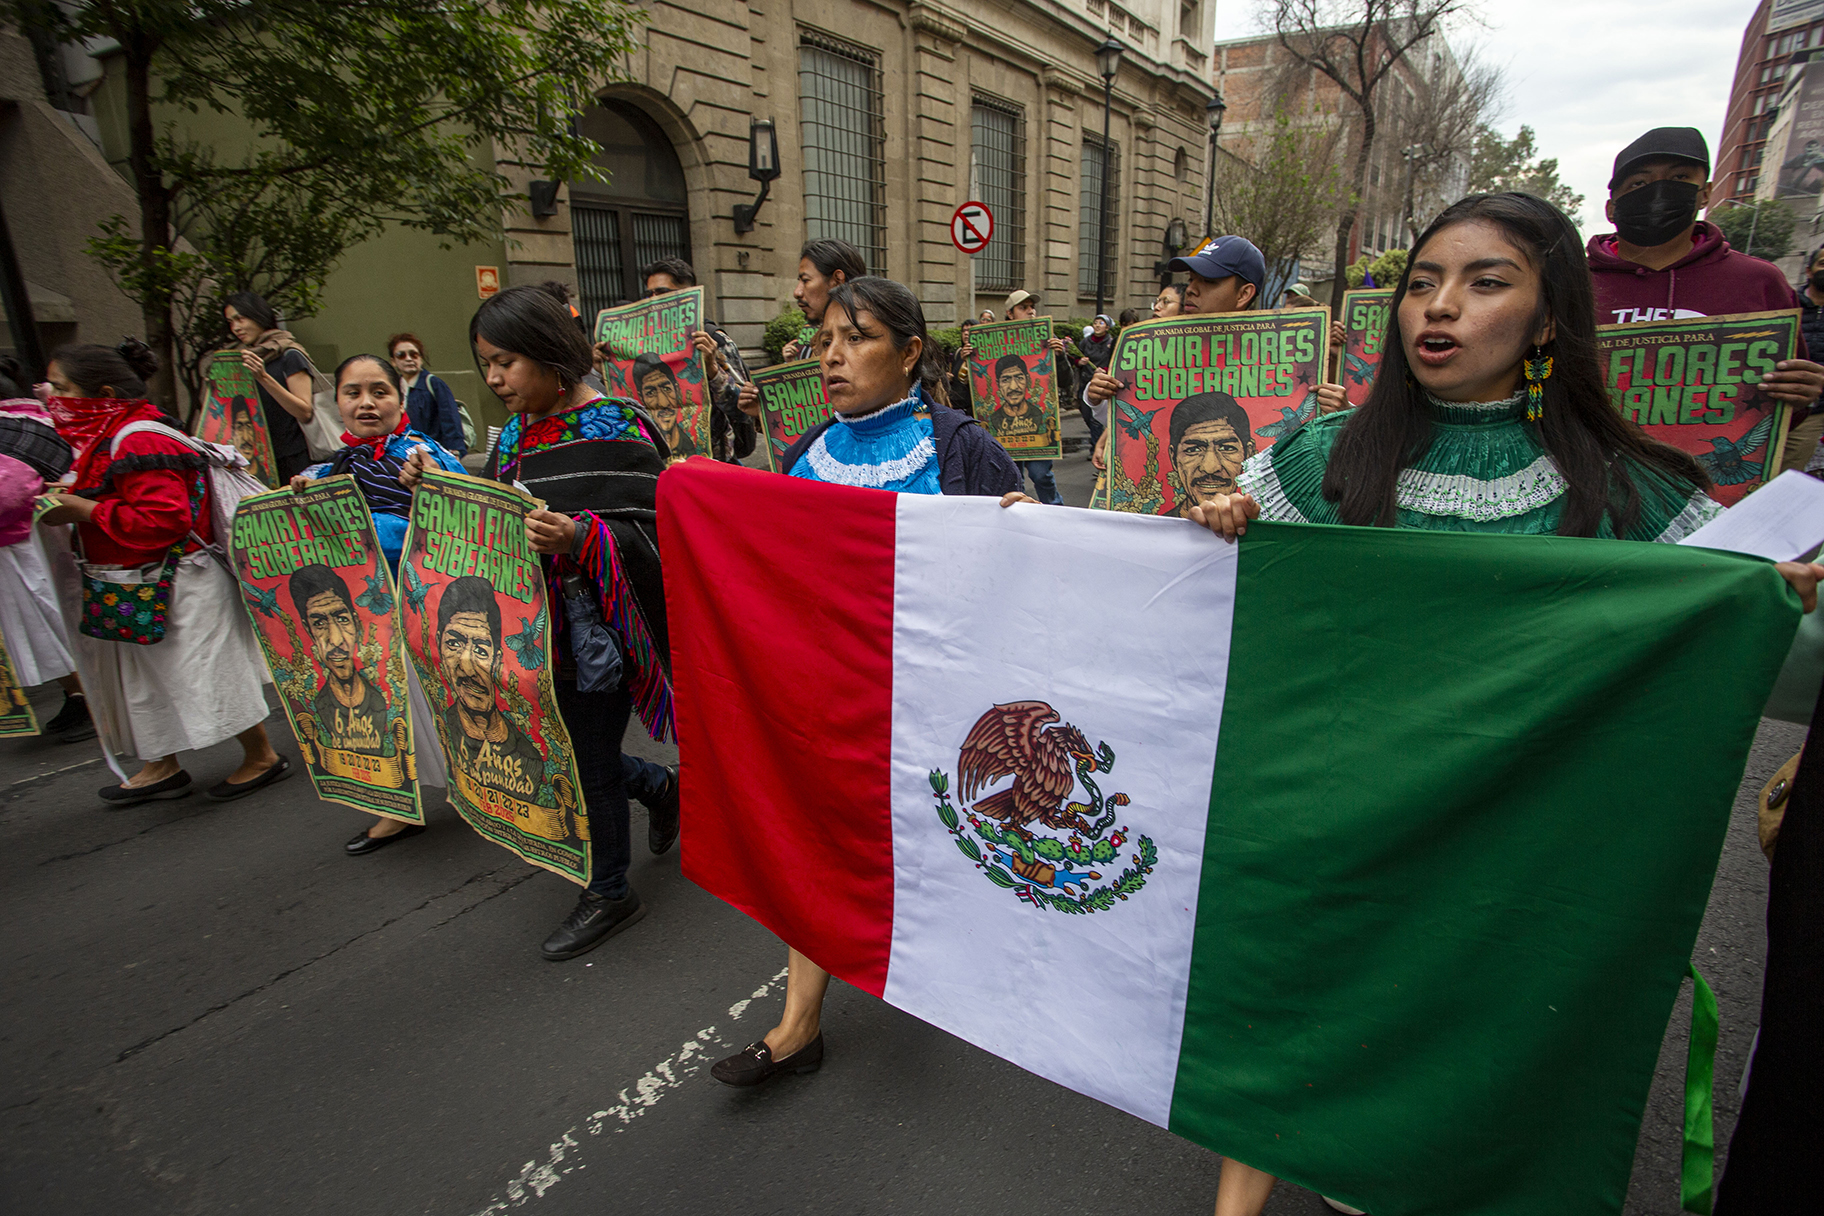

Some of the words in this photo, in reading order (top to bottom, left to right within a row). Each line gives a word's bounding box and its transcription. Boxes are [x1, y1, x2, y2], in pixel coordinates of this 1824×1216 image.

[601, 316, 645, 342] SAMIR
[647, 302, 695, 336] FLORES
[1152, 328, 1183, 338] JORNADA
[1184, 326, 1212, 334] GLOBAL
[1221, 323, 1255, 333] JUSTICIA
[1256, 322, 1276, 330] PARA
[1611, 307, 1675, 324] THE
[610, 328, 686, 362] SOBERANES
[970, 331, 1004, 348] SAMIR
[1007, 325, 1048, 344] FLORES
[978, 340, 1042, 360] SOBERANES
[1120, 334, 1202, 371] SAMIR
[1210, 328, 1315, 367] FLORES
[1615, 338, 1629, 347] DE
[1628, 335, 1680, 347] JUSTICIA
[1683, 333, 1715, 343] PARA
[1135, 362, 1294, 400] SOBERANES
[1607, 340, 1780, 388] FLORES
[762, 376, 825, 411] SAMIR
[1001, 418, 1008, 429] 6
[234, 509, 294, 550] SAMIR
[417, 491, 480, 543] SAMIR
[247, 531, 368, 580] SOBERANES
[422, 531, 533, 604] SOBERANES
[335, 708, 343, 733] 6
[346, 707, 373, 737] Años
[331, 731, 342, 748] de
[460, 736, 469, 760] 6
[472, 739, 522, 777] Años
[467, 761, 534, 795] impunidad
[479, 798, 493, 814] FEB
[487, 790, 499, 804] 21
[502, 795, 514, 812] 22
[516, 802, 530, 818] 23
